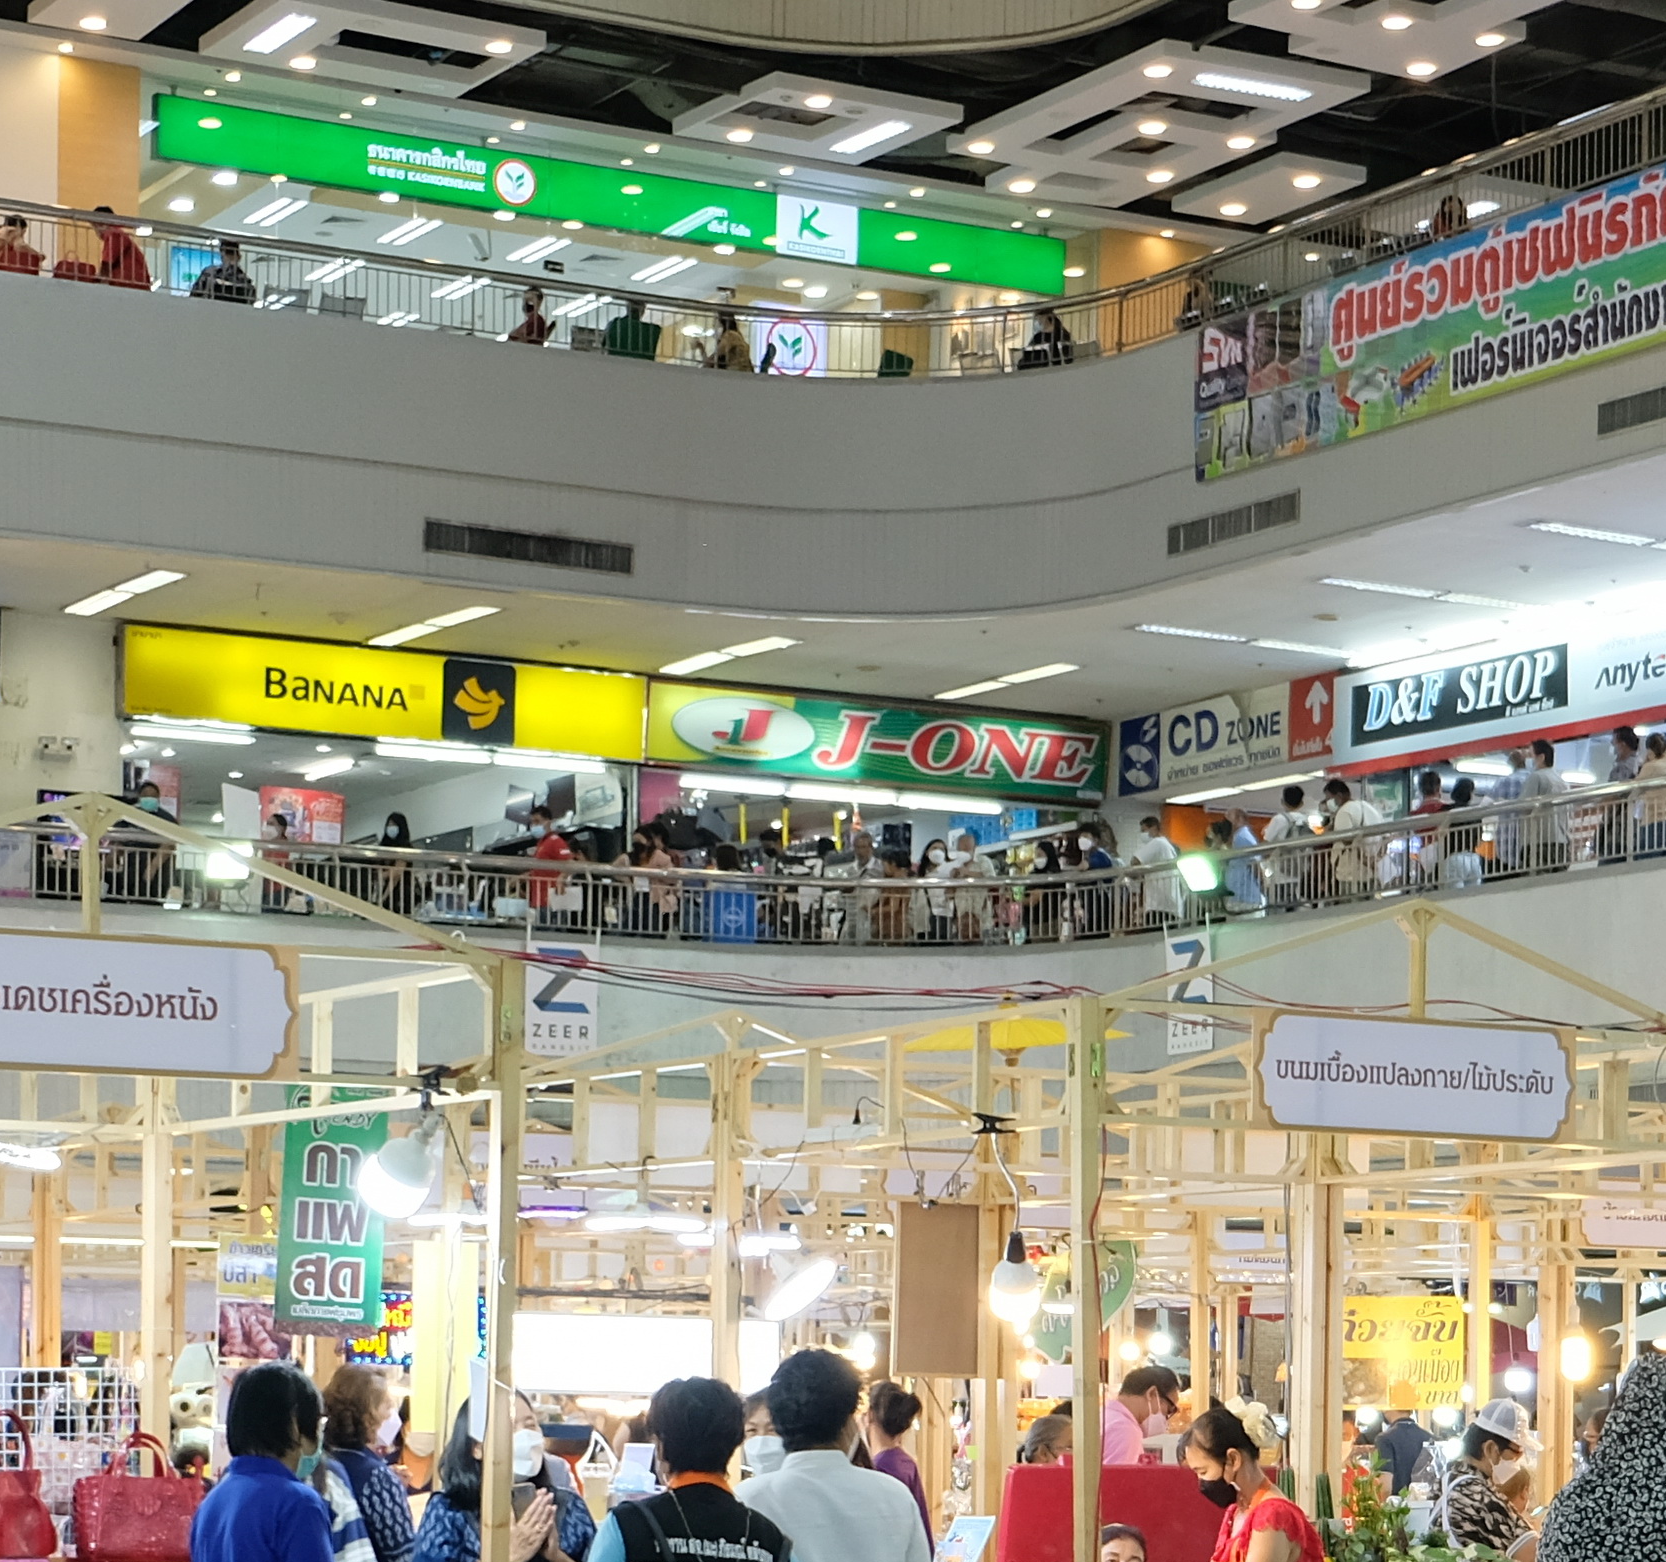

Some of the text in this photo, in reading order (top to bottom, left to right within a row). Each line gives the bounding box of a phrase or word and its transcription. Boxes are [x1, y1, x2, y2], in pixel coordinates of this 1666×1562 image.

[367, 143, 486, 174] ธนาคารกสิกรไทย
[799, 203, 832, 241] K
[1362, 650, 1556, 733] D&F SHOP
[812, 709, 1100, 788] J-ONE
[1168, 710, 1282, 757] CD ZONE
[532, 1023, 590, 1040] ZEER
[1275, 1049, 1554, 1095] ขนมเบื้องแปลงกาย/ไม้ประดับ
[294, 1197, 370, 1247] แฟ
[291, 1253, 366, 1304] สด
